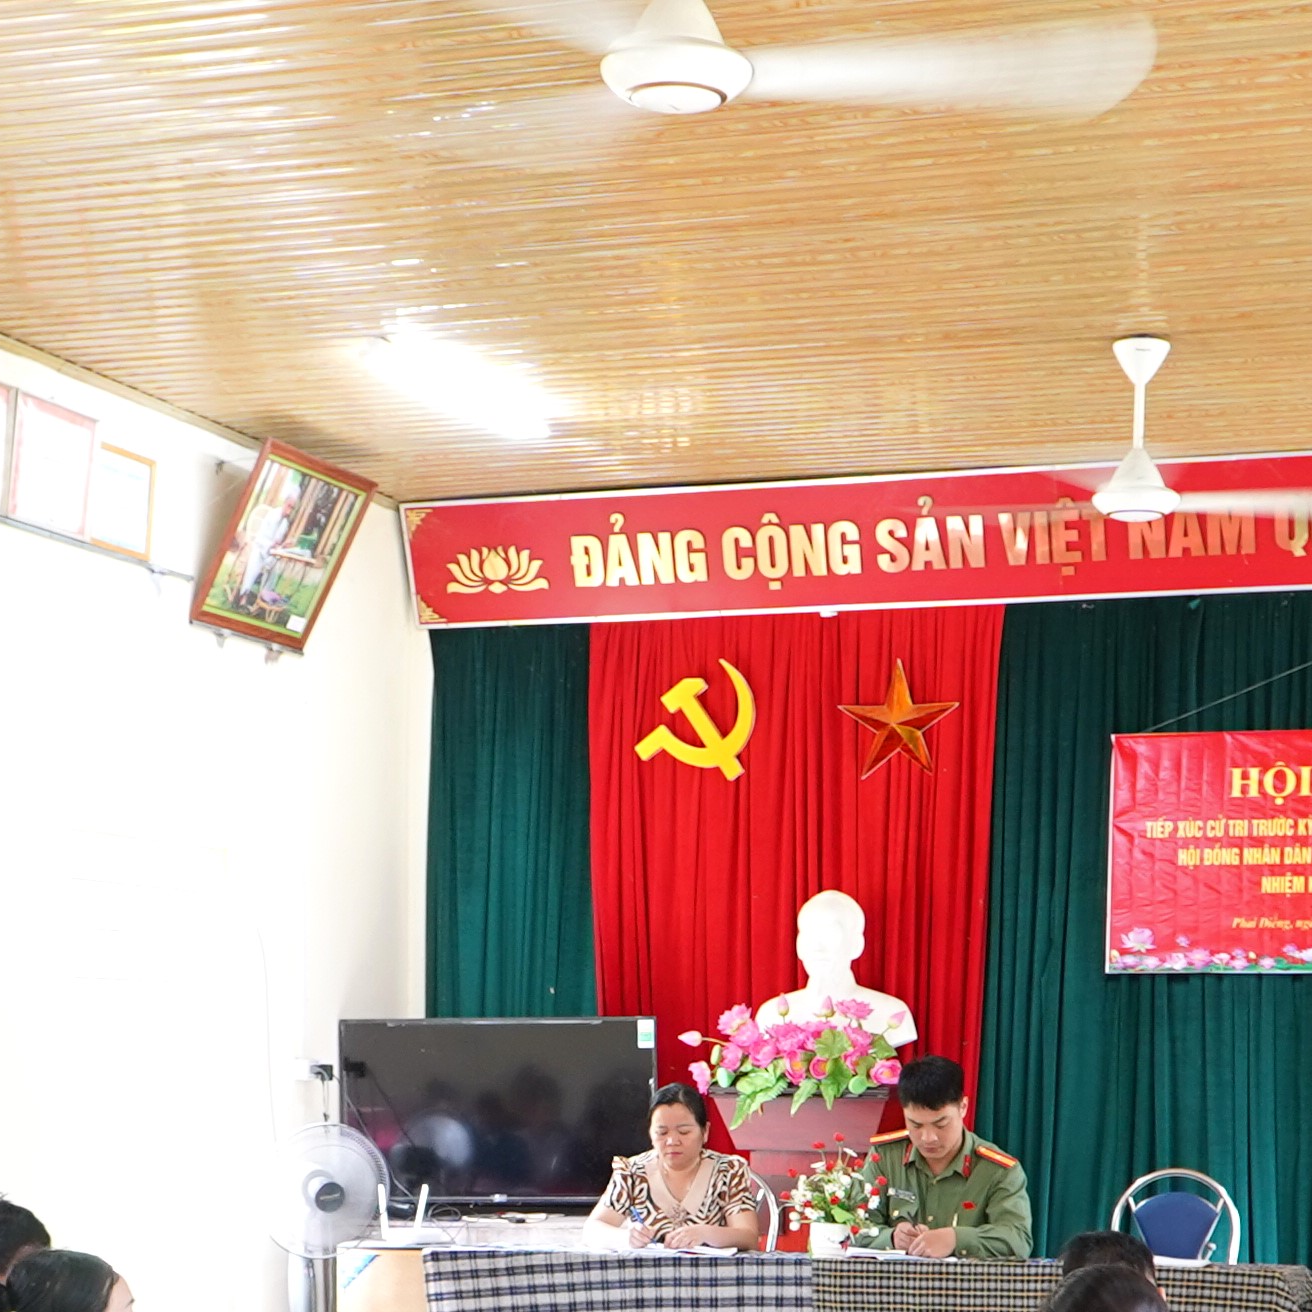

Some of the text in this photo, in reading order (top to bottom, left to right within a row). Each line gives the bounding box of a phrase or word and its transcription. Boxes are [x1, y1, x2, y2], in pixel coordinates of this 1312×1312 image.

[569, 512, 709, 588] ĐẢNG
[721, 512, 863, 591] CỘNG
[874, 495, 986, 574] SẢN
[997, 497, 1108, 576] VIỆT
[1146, 816, 1174, 839] TIẾP
[1207, 815, 1227, 838] CỬ
[1228, 820, 1249, 838] TRI
[1178, 845, 1201, 870] HỘI
[1244, 844, 1281, 865] NHÂN
[1284, 843, 1312, 865] DÂN
[1261, 872, 1306, 898] NHIỆM
